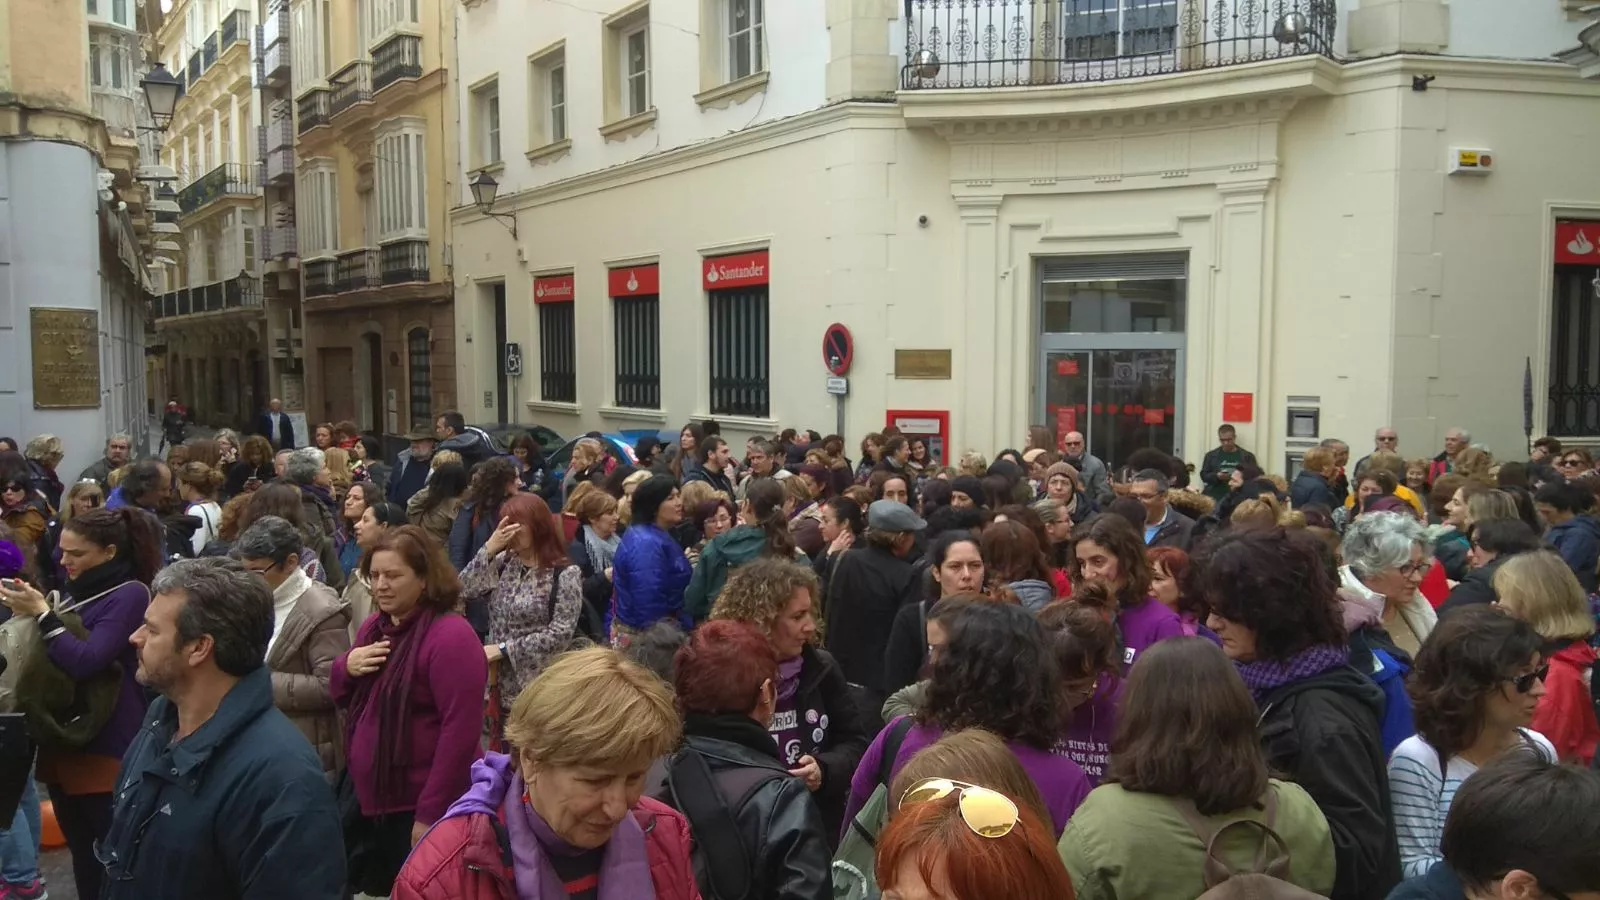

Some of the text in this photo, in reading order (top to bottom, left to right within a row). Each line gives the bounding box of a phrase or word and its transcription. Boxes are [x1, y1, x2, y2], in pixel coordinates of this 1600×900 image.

[719, 261, 765, 280] Santander
[543, 280, 572, 296] Santander
[1071, 752, 1086, 762] QUE
[1089, 754, 1112, 764] NUNC
